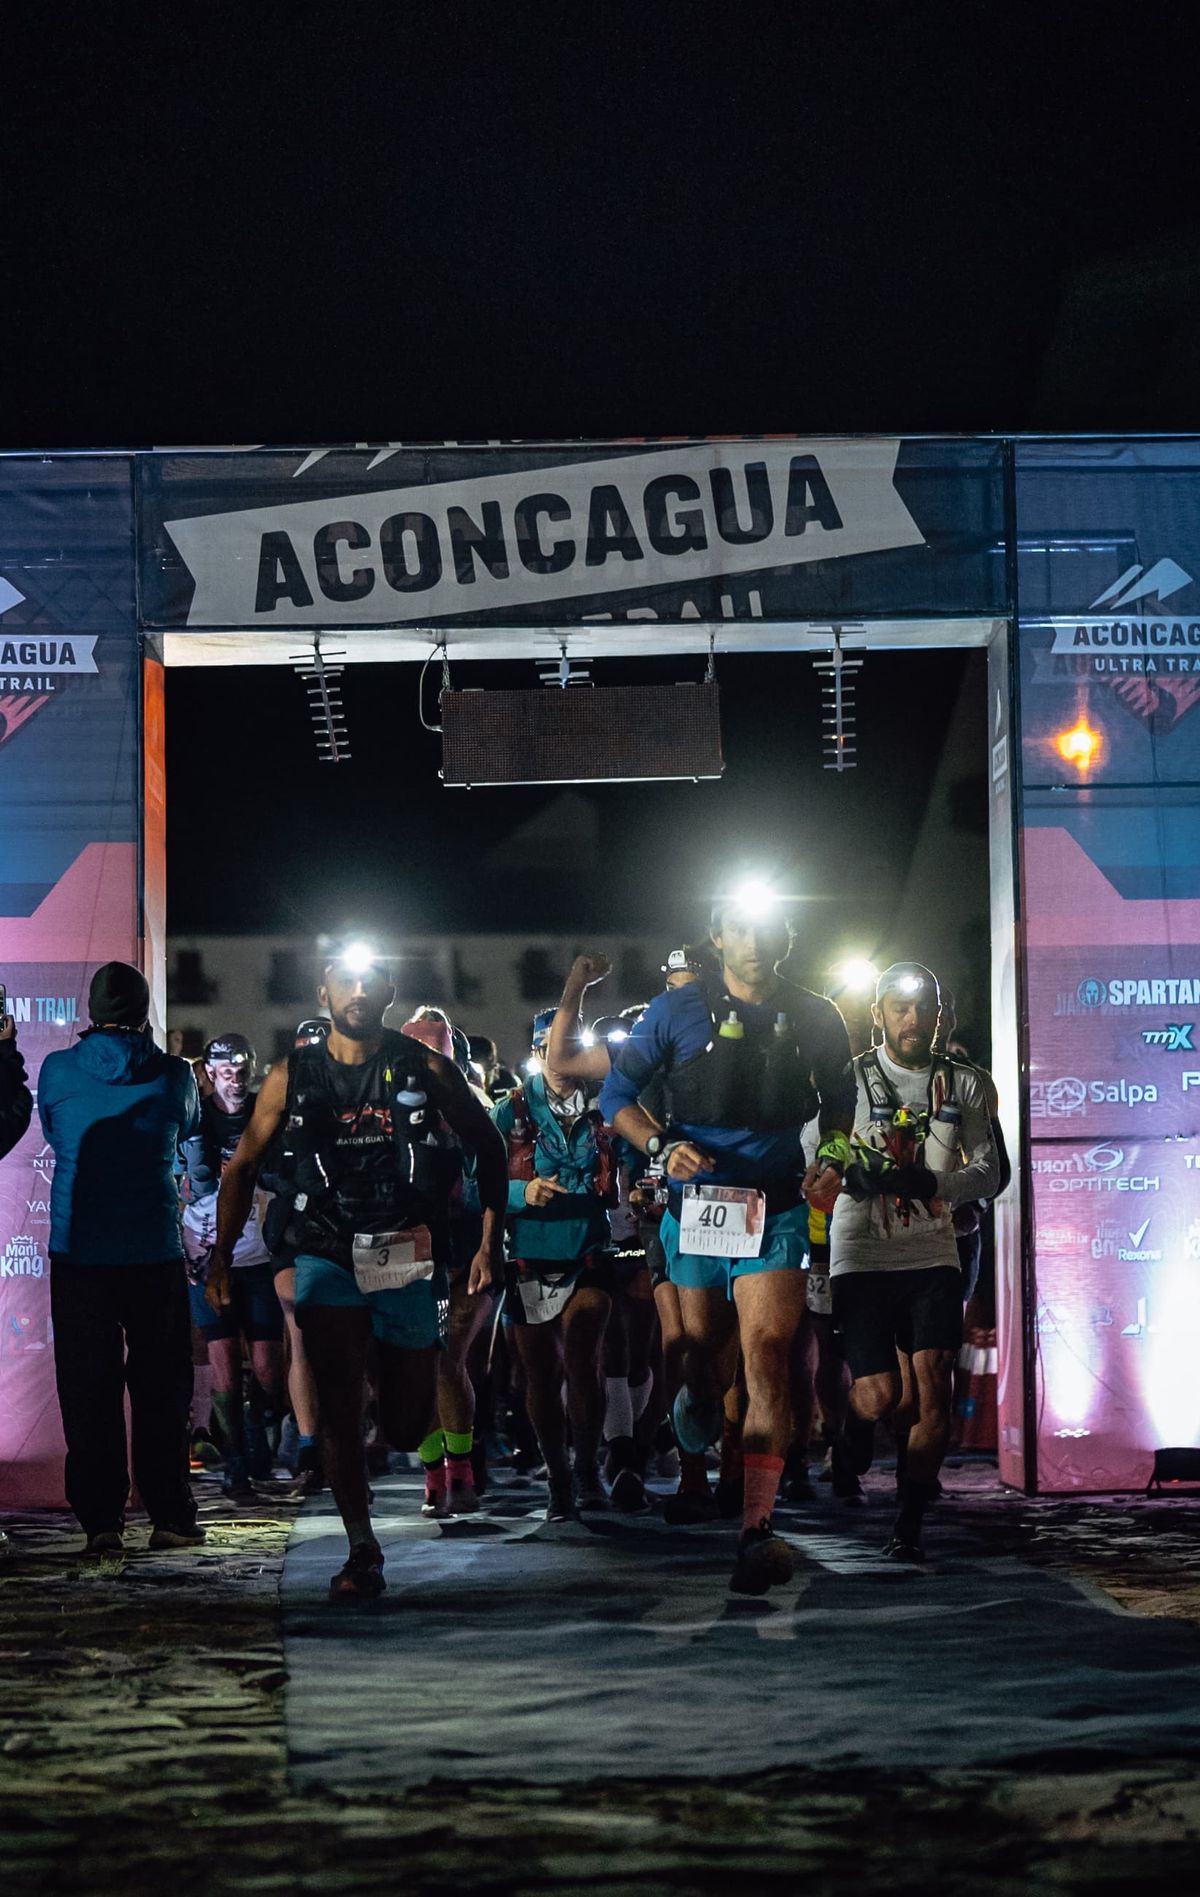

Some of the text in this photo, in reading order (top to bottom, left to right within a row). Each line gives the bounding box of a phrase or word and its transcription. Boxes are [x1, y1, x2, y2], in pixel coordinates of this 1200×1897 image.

[254, 455, 844, 613] ACONCAGUA
[1, 642, 76, 665] AGUA
[1095, 658, 1157, 672] ULTRA
[0, 677, 55, 690] TRAIL
[36, 998, 80, 1023] TRAIL
[1090, 1079, 1157, 1107] Salpa
[1049, 1176, 1160, 1192] OPTITECH
[698, 1204, 727, 1228] 40
[6, 1242, 38, 1256] Maní
[377, 1248, 390, 1267] 3
[1, 1255, 44, 1278] King
